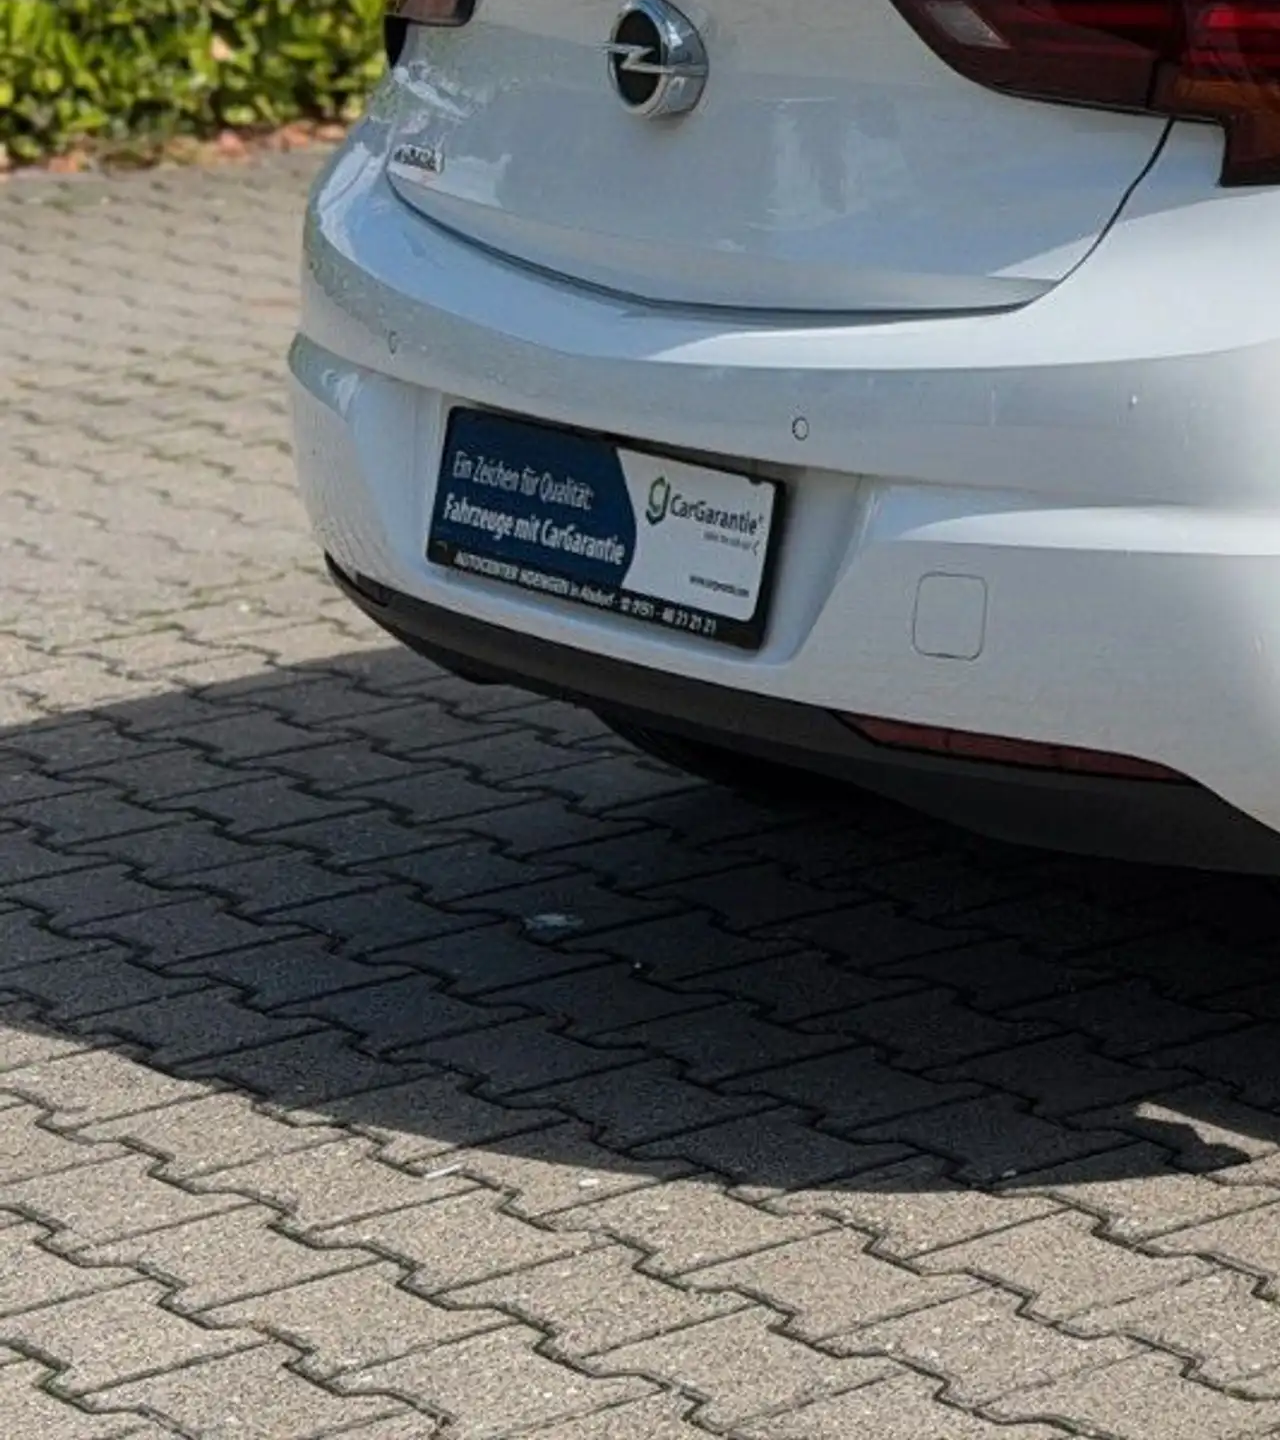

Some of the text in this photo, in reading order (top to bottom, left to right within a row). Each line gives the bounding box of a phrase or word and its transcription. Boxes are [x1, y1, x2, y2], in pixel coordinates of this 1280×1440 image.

[453, 449, 472, 479] Ein
[473, 456, 519, 493] Zeichen
[519, 464, 540, 496] für
[443, 492, 626, 566] Fahrzeuge mit CarGarantie
